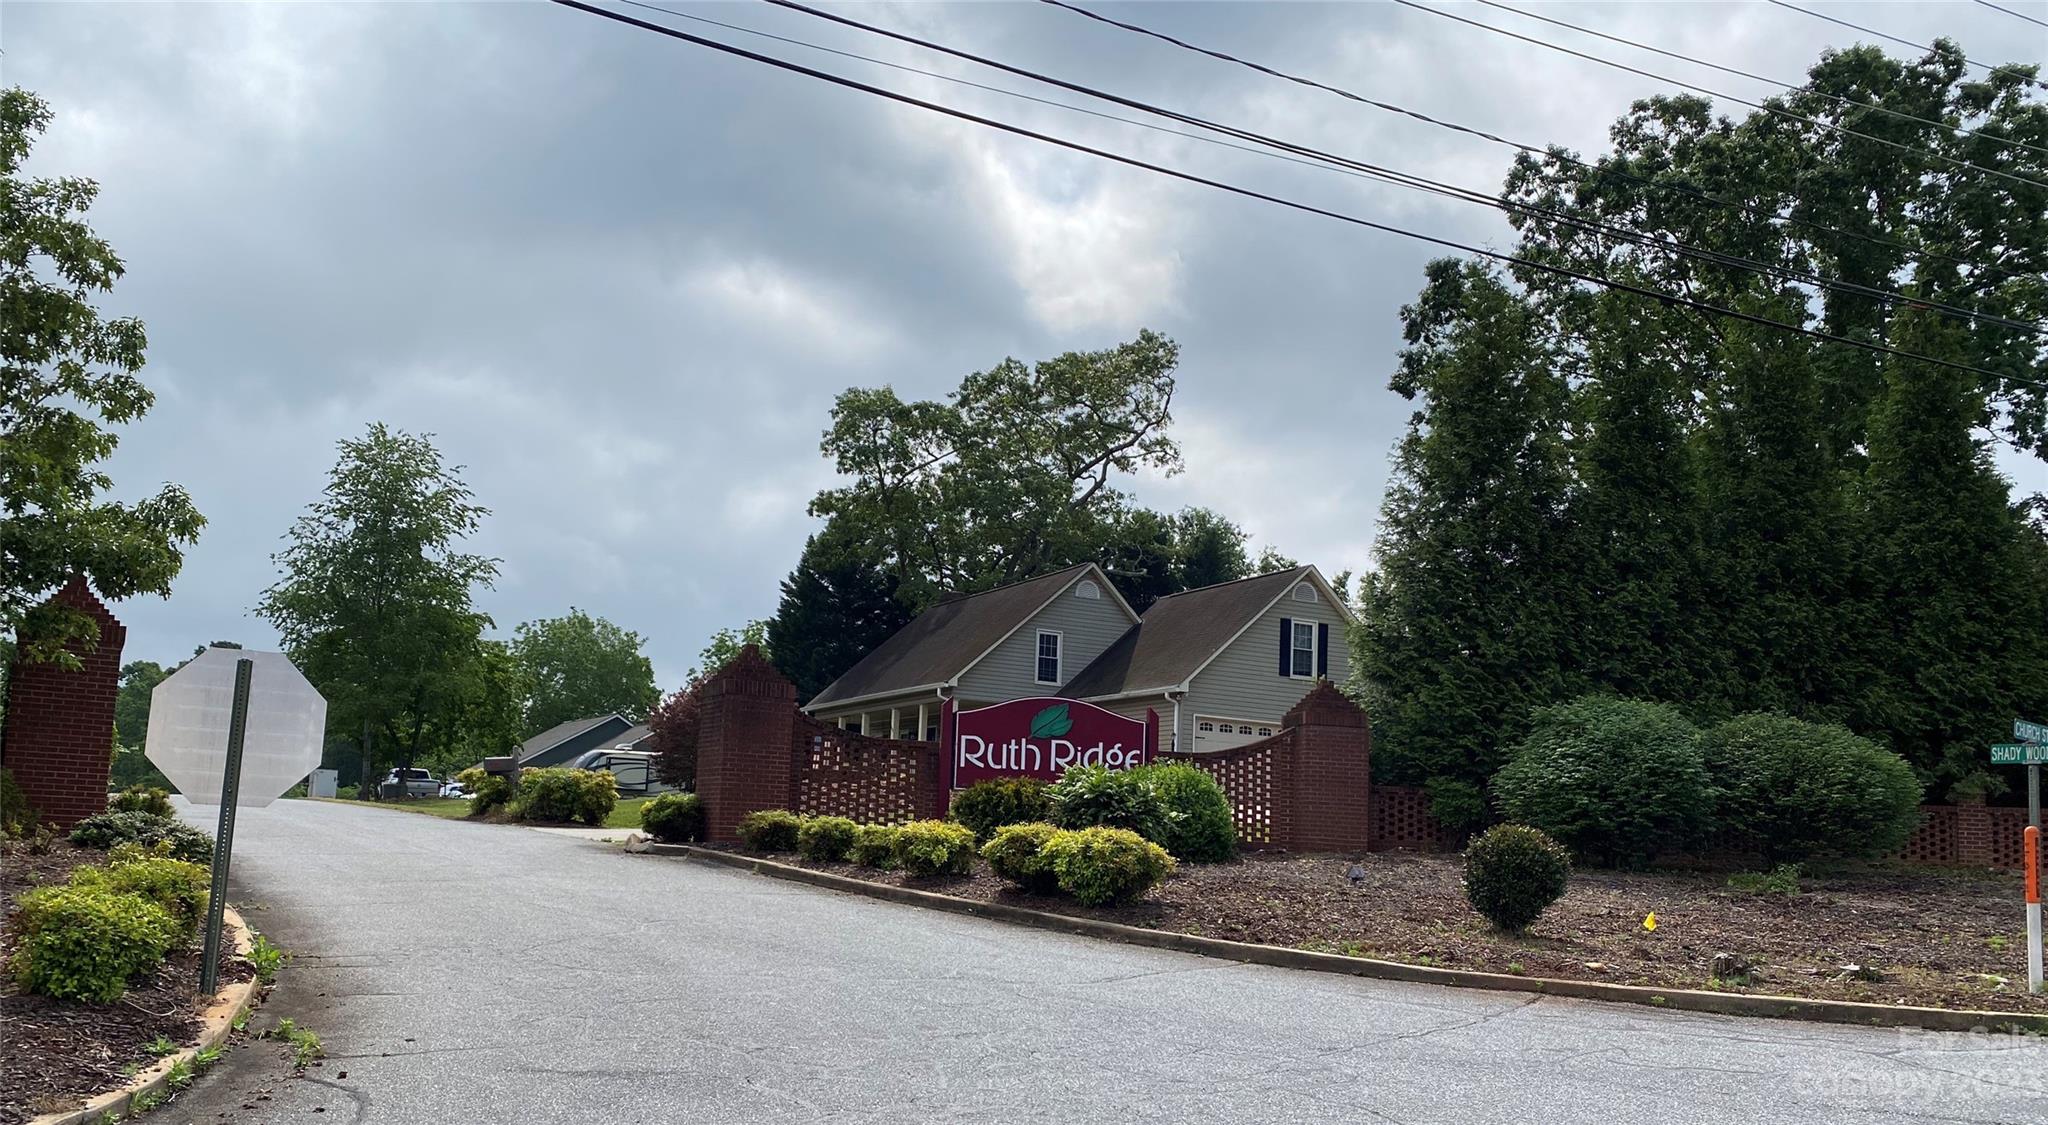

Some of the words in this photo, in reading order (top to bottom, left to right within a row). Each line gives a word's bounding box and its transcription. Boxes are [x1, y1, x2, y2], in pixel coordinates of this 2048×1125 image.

[2015, 722, 2040, 741] CHURCH
[960, 735, 1041, 771] Ruth
[1050, 739, 1140, 771] Ridge
[1991, 747, 2021, 761] SHADY
